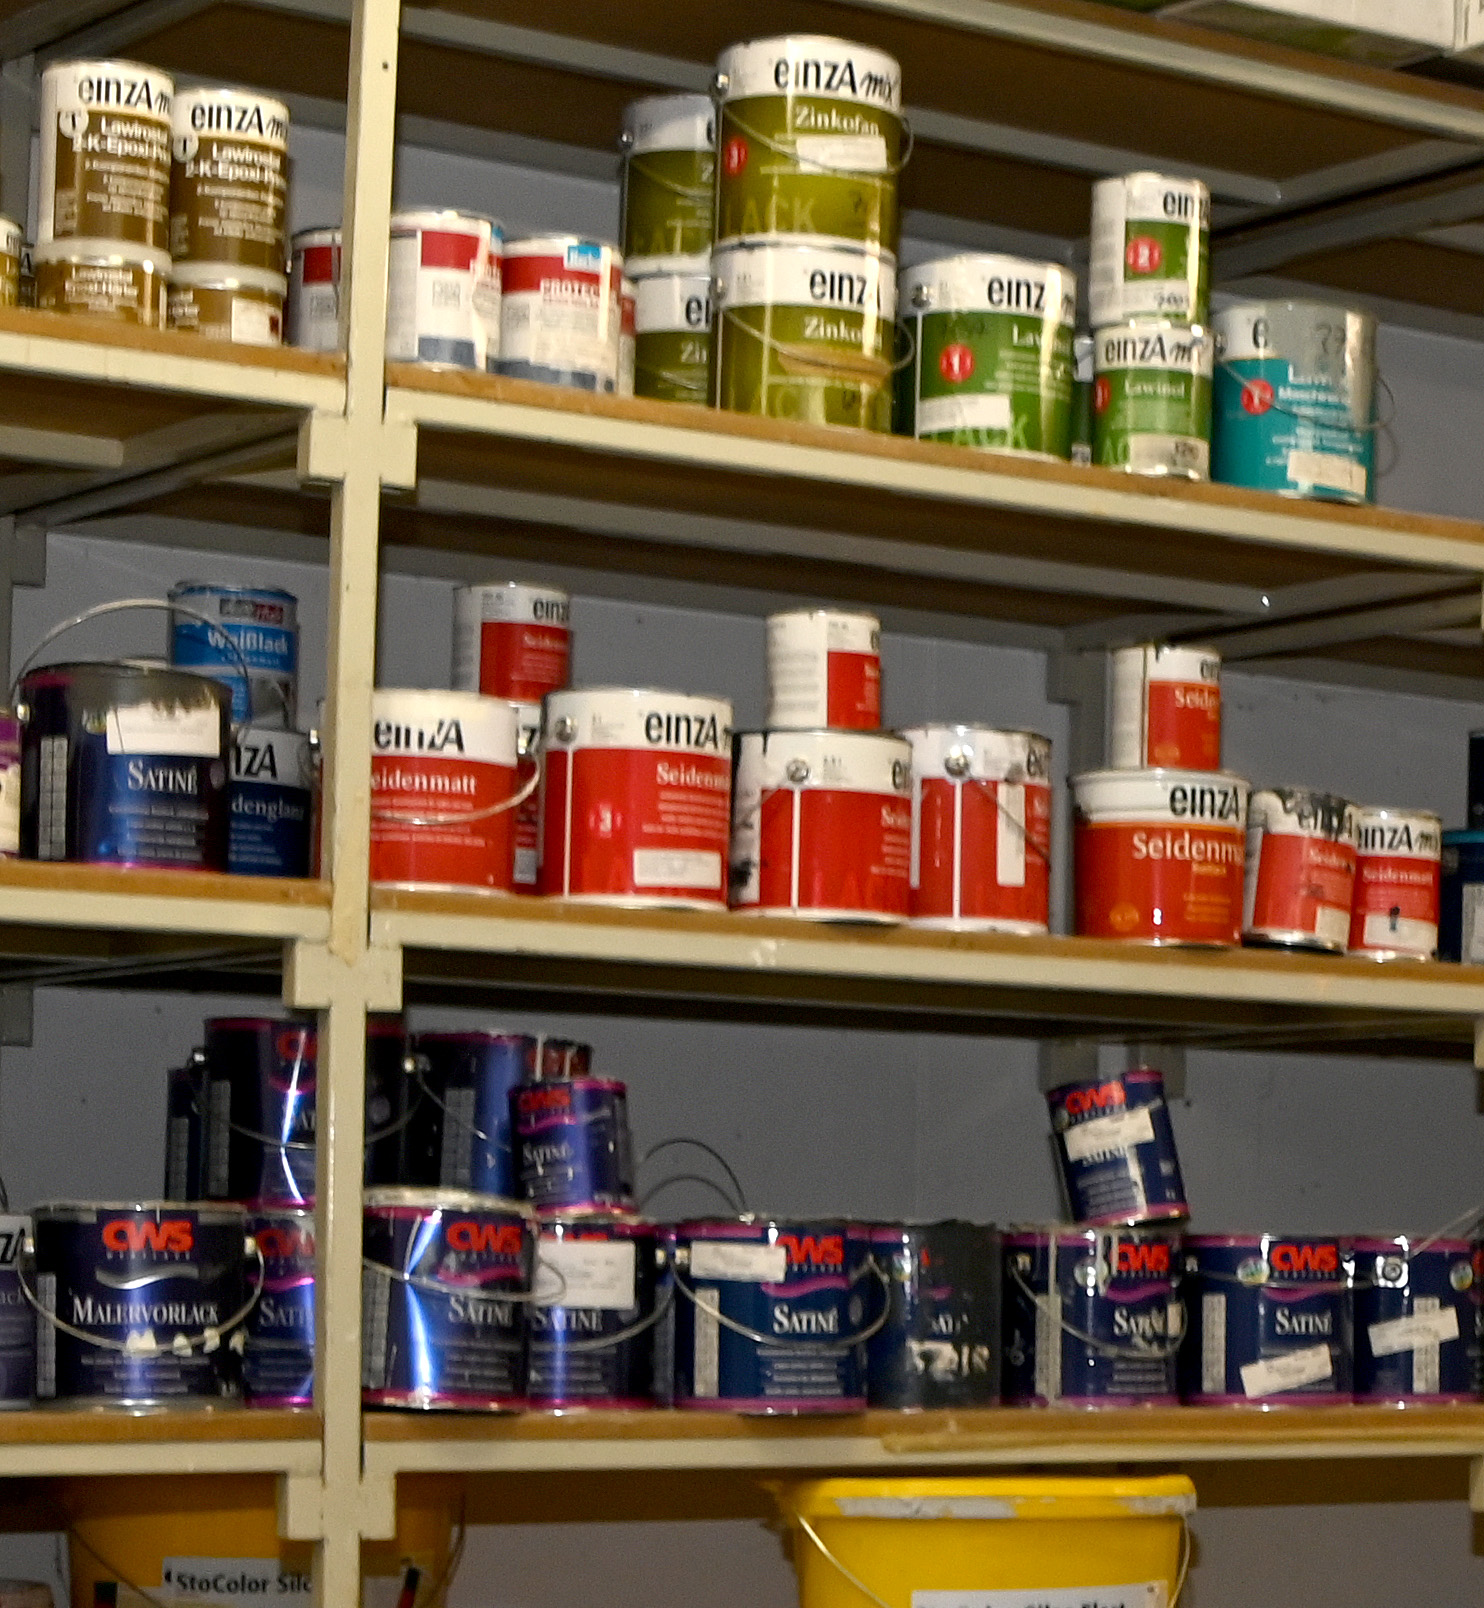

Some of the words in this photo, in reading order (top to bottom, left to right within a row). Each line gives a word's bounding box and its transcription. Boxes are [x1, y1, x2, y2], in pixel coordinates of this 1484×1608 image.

[78, 76, 153, 110] einzA
[775, 58, 858, 95] einzA
[191, 102, 265, 135] einzA
[1104, 334, 1166, 364] einzA
[532, 597, 570, 627] einz
[373, 718, 465, 754] einzA
[644, 710, 720, 751] einzA
[230, 740, 278, 779] nzA
[372, 766, 477, 796] eidenmatt
[1169, 783, 1241, 821] einzA
[1132, 831, 1244, 863] Seidenm
[1065, 1080, 1126, 1115] CWS
[102, 1219, 194, 1254] CWS
[446, 1221, 522, 1254] CWS
[1270, 1244, 1338, 1271] CWS
[72, 1296, 219, 1326] MALERVORLACK
[176, 1572, 268, 1595] StoColor
[277, 1572, 312, 1594] Silc
